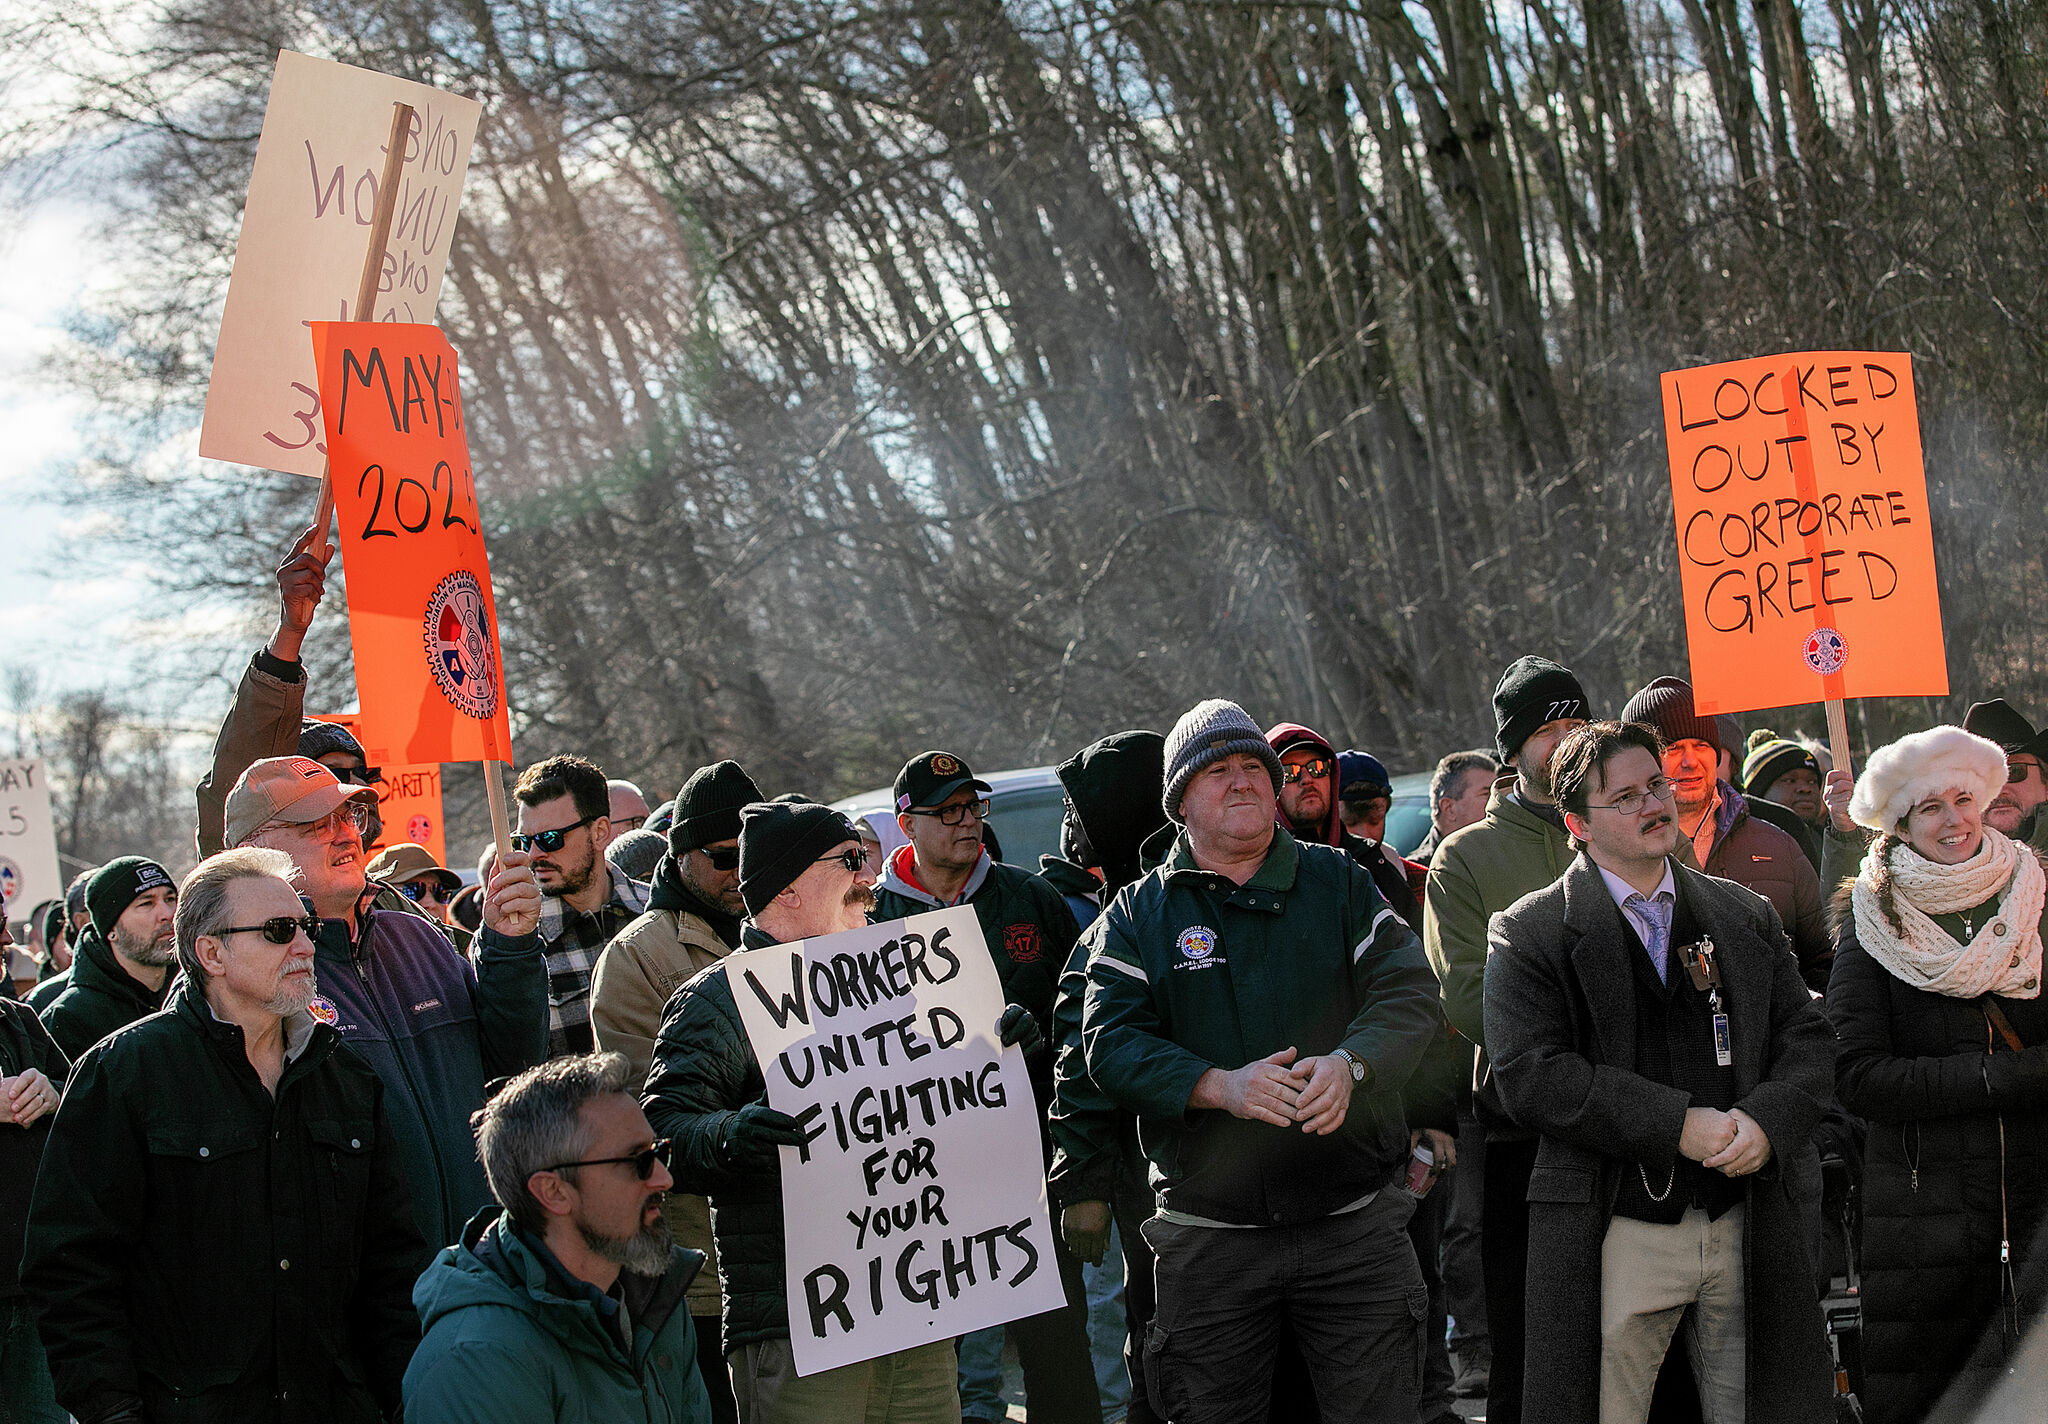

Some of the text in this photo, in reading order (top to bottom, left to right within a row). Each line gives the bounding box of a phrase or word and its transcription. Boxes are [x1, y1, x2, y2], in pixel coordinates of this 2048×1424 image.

[1675, 363, 1897, 432] LOCKED
[1692, 421, 1884, 492] OUT BY
[1684, 491, 1911, 566] CORPORATE
[1705, 550, 1897, 634] GREED
[1545, 699, 1580, 721] 777
[743, 926, 961, 1030] WORKERS
[1015, 936, 1031, 951] 17
[778, 1007, 965, 1089] UNITED
[795, 1061, 1007, 1165] FIGHTING
[861, 1136, 938, 1197] FOR
[846, 1185, 949, 1250] YOUR
[802, 1217, 1039, 1338] RIGHTS
